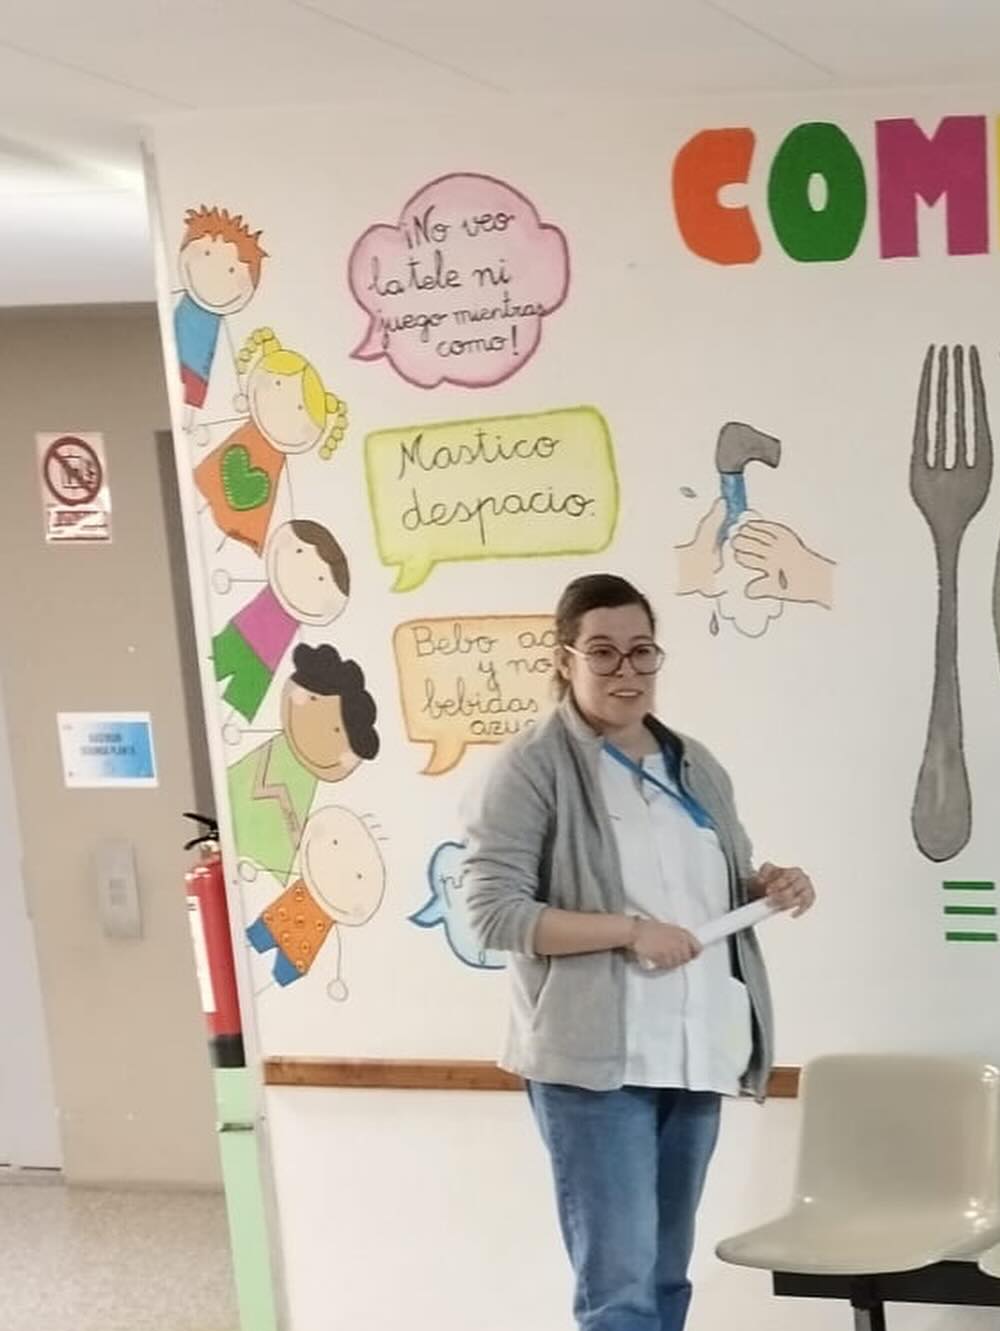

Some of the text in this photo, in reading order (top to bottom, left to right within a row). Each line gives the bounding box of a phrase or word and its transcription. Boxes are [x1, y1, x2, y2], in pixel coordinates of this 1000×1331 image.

[462, 211, 516, 238] veo
[368, 250, 512, 297] la tele ni
[376, 291, 546, 350] juego mientras
[436, 325, 519, 358] como!
[398, 427, 560, 480] Mastico
[402, 487, 596, 546] despacio.
[410, 622, 500, 657] Bebo
[478, 657, 554, 692] y no
[421, 676, 539, 719] bebidas
